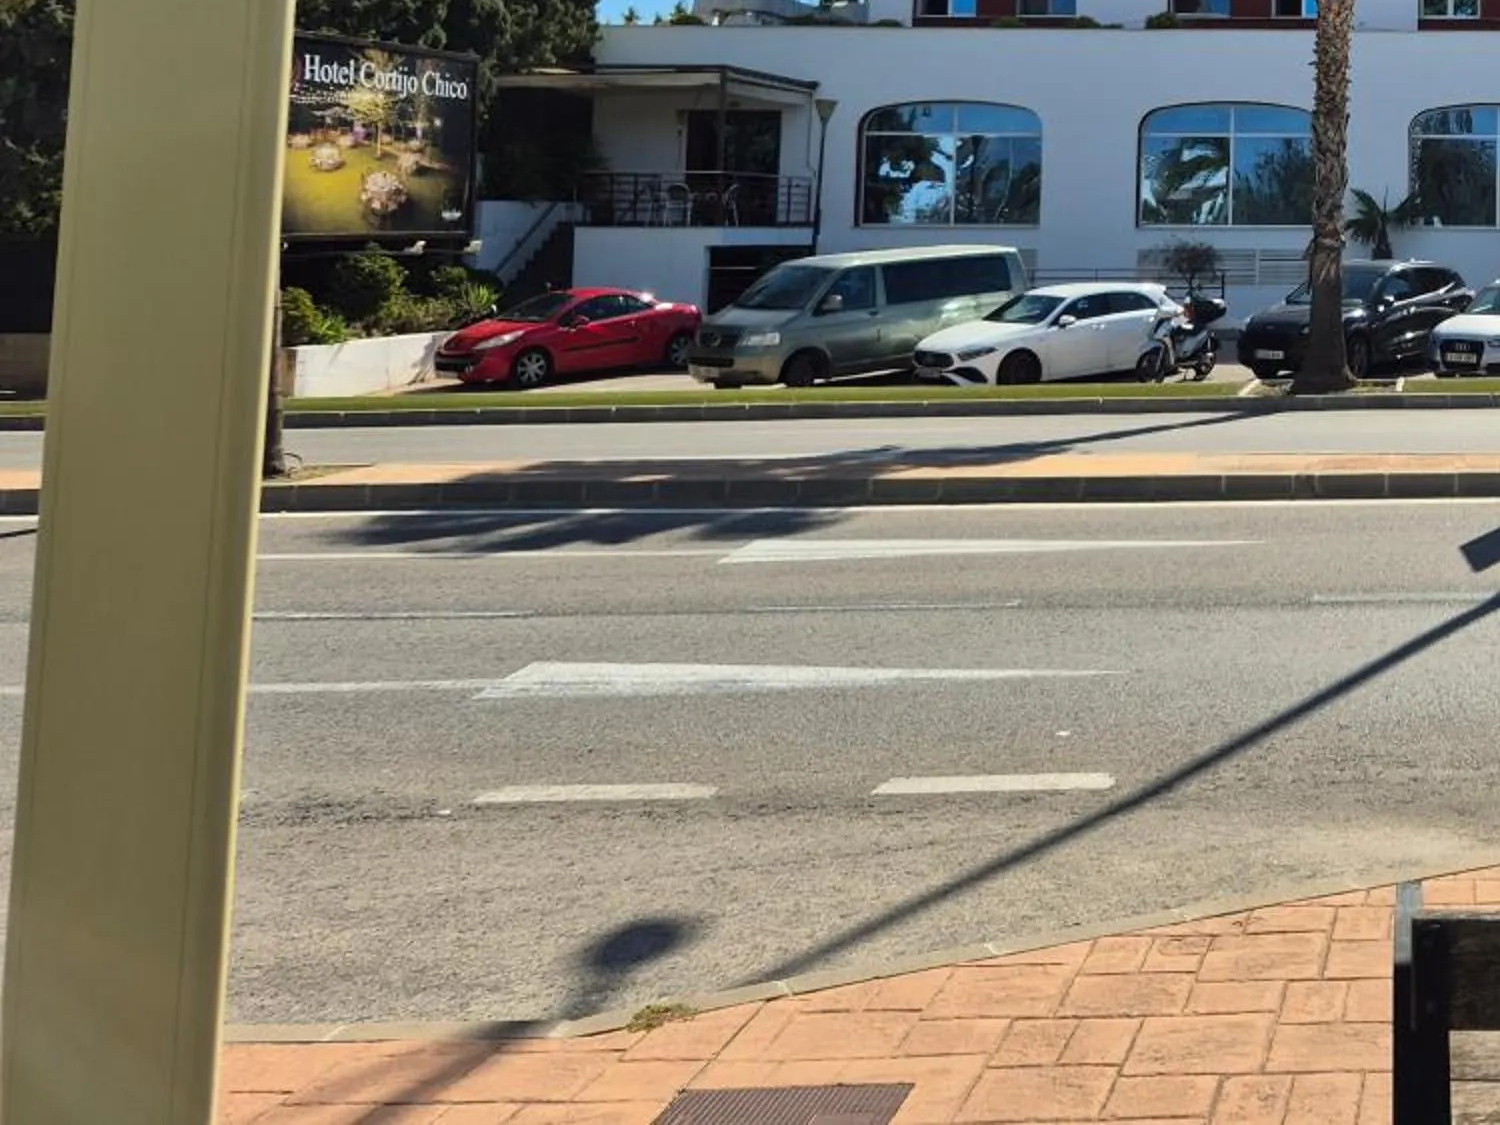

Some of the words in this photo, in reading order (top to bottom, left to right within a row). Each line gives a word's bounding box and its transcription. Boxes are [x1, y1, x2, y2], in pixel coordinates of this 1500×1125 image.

[303, 53, 355, 86] Hotel
[359, 61, 419, 98] Cortijo
[421, 70, 468, 100] Chico
